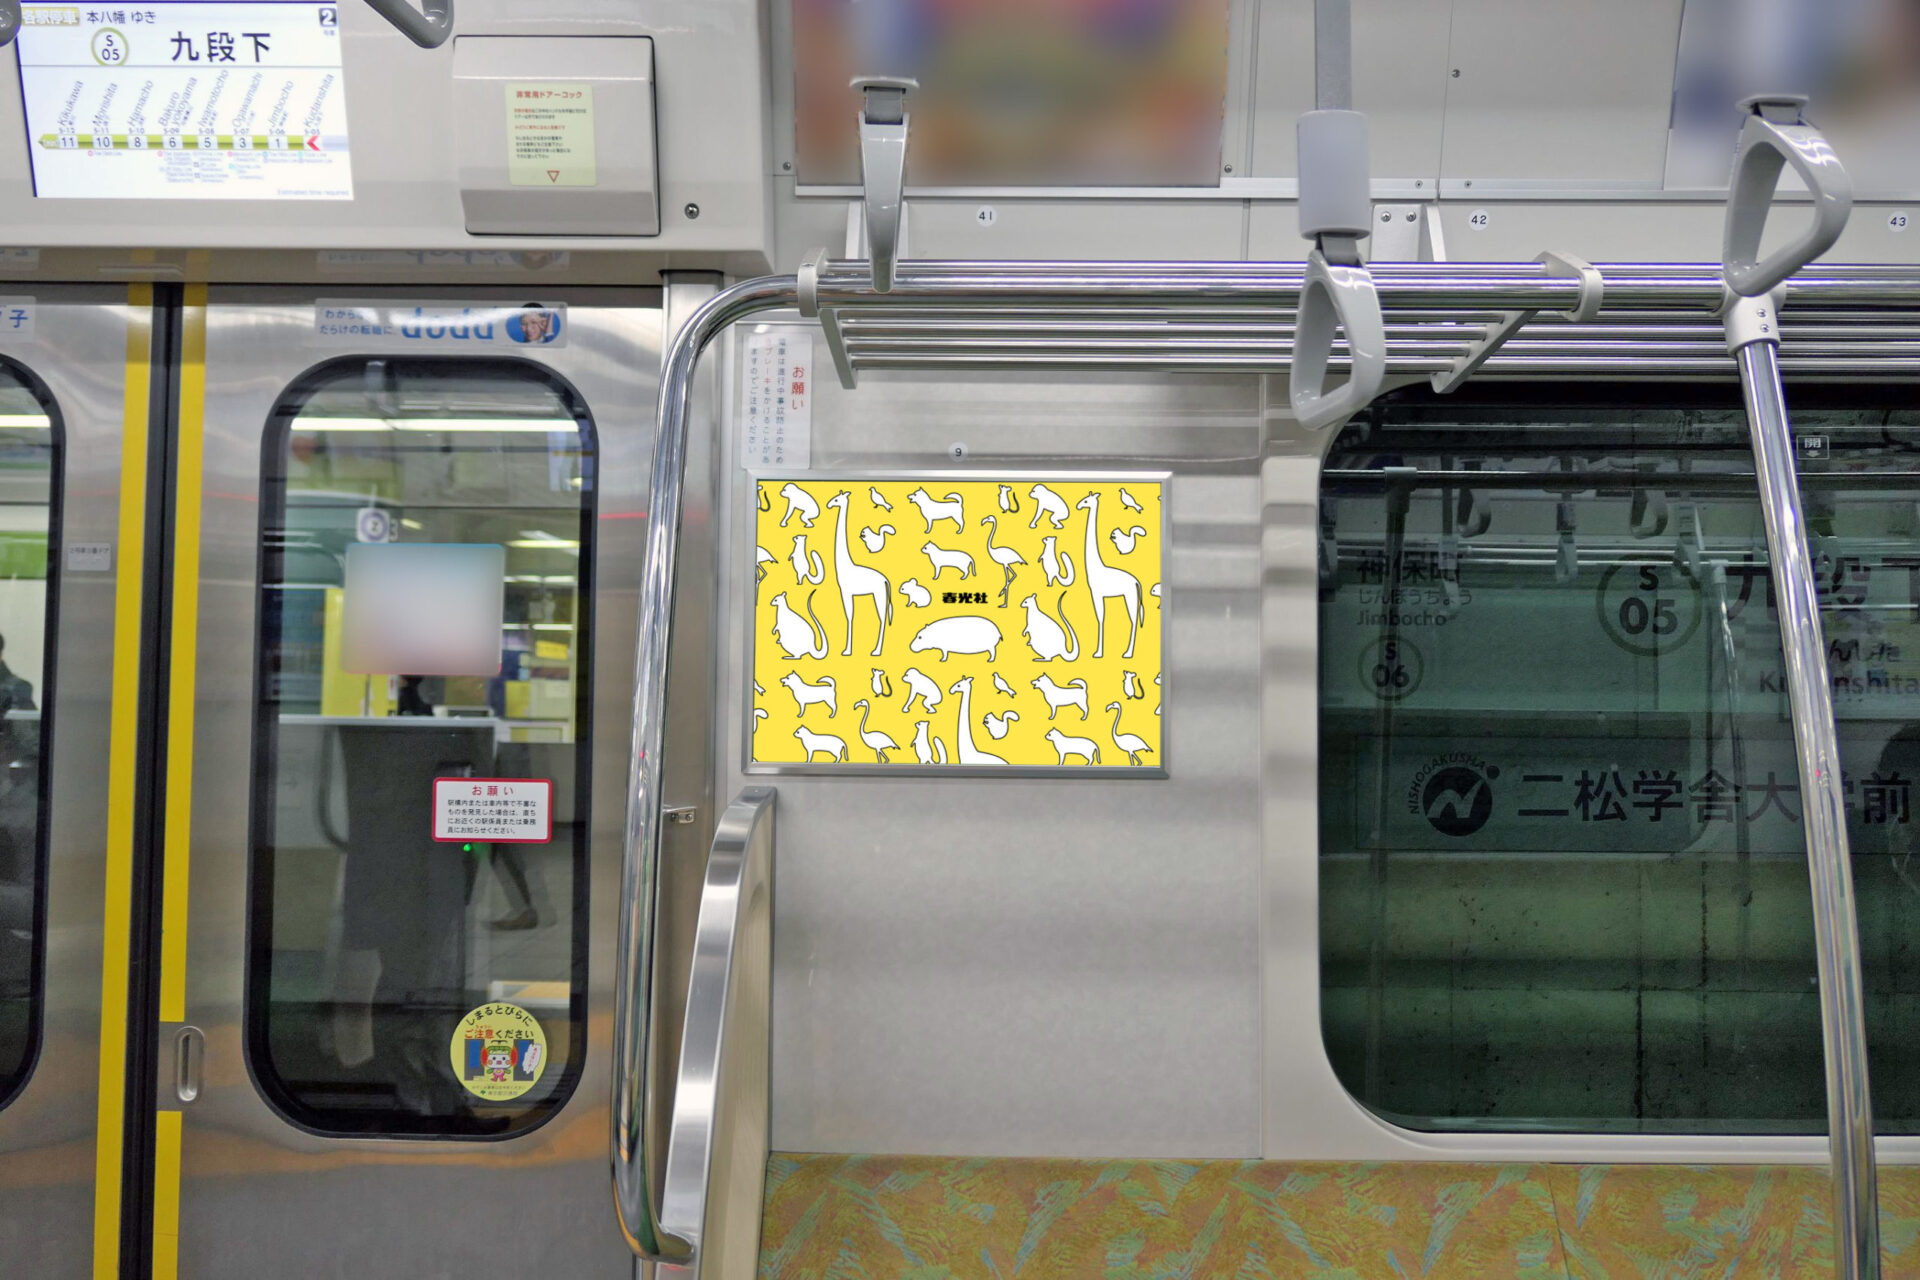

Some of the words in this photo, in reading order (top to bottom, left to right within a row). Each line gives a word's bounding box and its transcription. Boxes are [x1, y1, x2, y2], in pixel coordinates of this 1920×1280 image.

[87, 11, 125, 24] 本八幡
[131, 11, 156, 24] ゆき
[322, 9, 333, 25] 2
[106, 35, 114, 46] S
[171, 31, 270, 62] 九段下
[102, 49, 120, 60] 05
[57, 80, 84, 126] Kikukawa
[92, 82, 118, 126] Morishita
[127, 80, 154, 126] Hamacho
[198, 69, 229, 127] Iwamotocho
[232, 72, 263, 127] Ogawamachi
[267, 80, 294, 127] Jimbocho
[304, 74, 334, 127] Kudanshita
[61, 137, 75, 147] 11
[96, 137, 110, 147] 10
[134, 136, 142, 148] 8
[169, 137, 177, 148] 6
[204, 137, 212, 148] 5
[239, 137, 247, 148] 3
[275, 138, 281, 148] 1
[978, 211, 992, 221] 41
[1471, 215, 1487, 225] 42
[1890, 217, 1906, 227] 43
[792, 366, 804, 410] お願い
[955, 447, 962, 457] 9
[1640, 564, 1659, 591] S
[942, 592, 988, 604] 春光社
[1357, 609, 1447, 626] Jimbocho
[1620, 598, 1678, 635] 05
[1385, 641, 1397, 660] S
[1372, 664, 1410, 688] 06
[1760, 669, 1920, 694] Knshita
[472, 785, 514, 796] お願い
[1518, 769, 1912, 824] 二松学舎大前
[466, 1005, 533, 1027] しまるとびらに
[465, 1029, 533, 1039] ご注意ください
